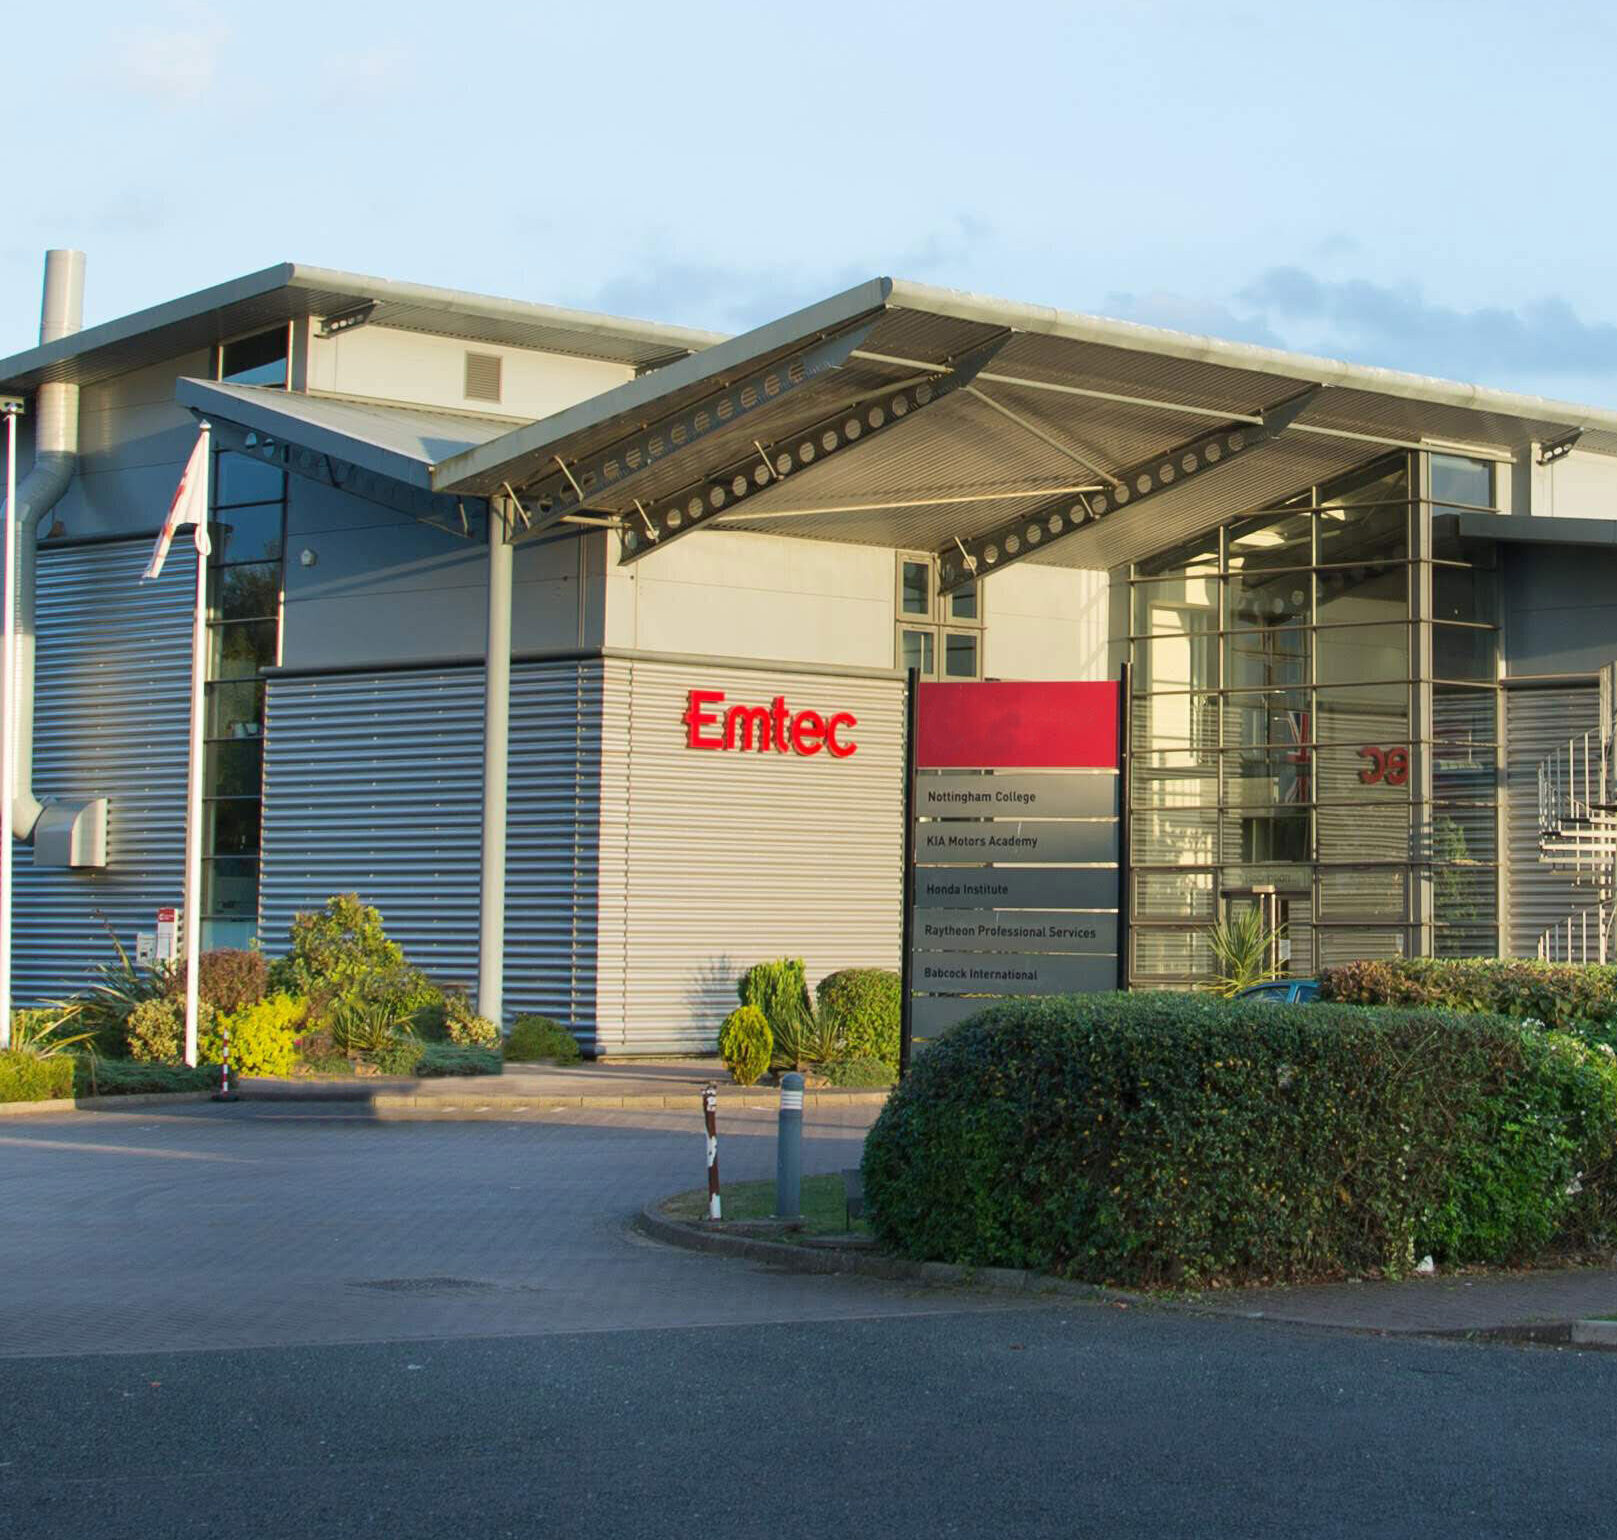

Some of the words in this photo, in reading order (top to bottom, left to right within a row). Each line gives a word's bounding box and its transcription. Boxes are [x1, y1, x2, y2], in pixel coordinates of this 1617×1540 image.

[682, 689, 858, 759] Emtec
[928, 791, 992, 804] Nottingham
[995, 791, 1036, 804] College
[926, 836, 945, 847] KIA
[948, 836, 986, 847] Motors
[988, 835, 1038, 849] Academy
[926, 883, 960, 895] Honda
[963, 884, 1009, 896] Institute
[924, 924, 975, 939] Raytheon
[978, 925, 1046, 938] Professional
[1049, 926, 1097, 939] Services
[924, 967, 967, 979] Babcock
[969, 968, 1038, 981] International
